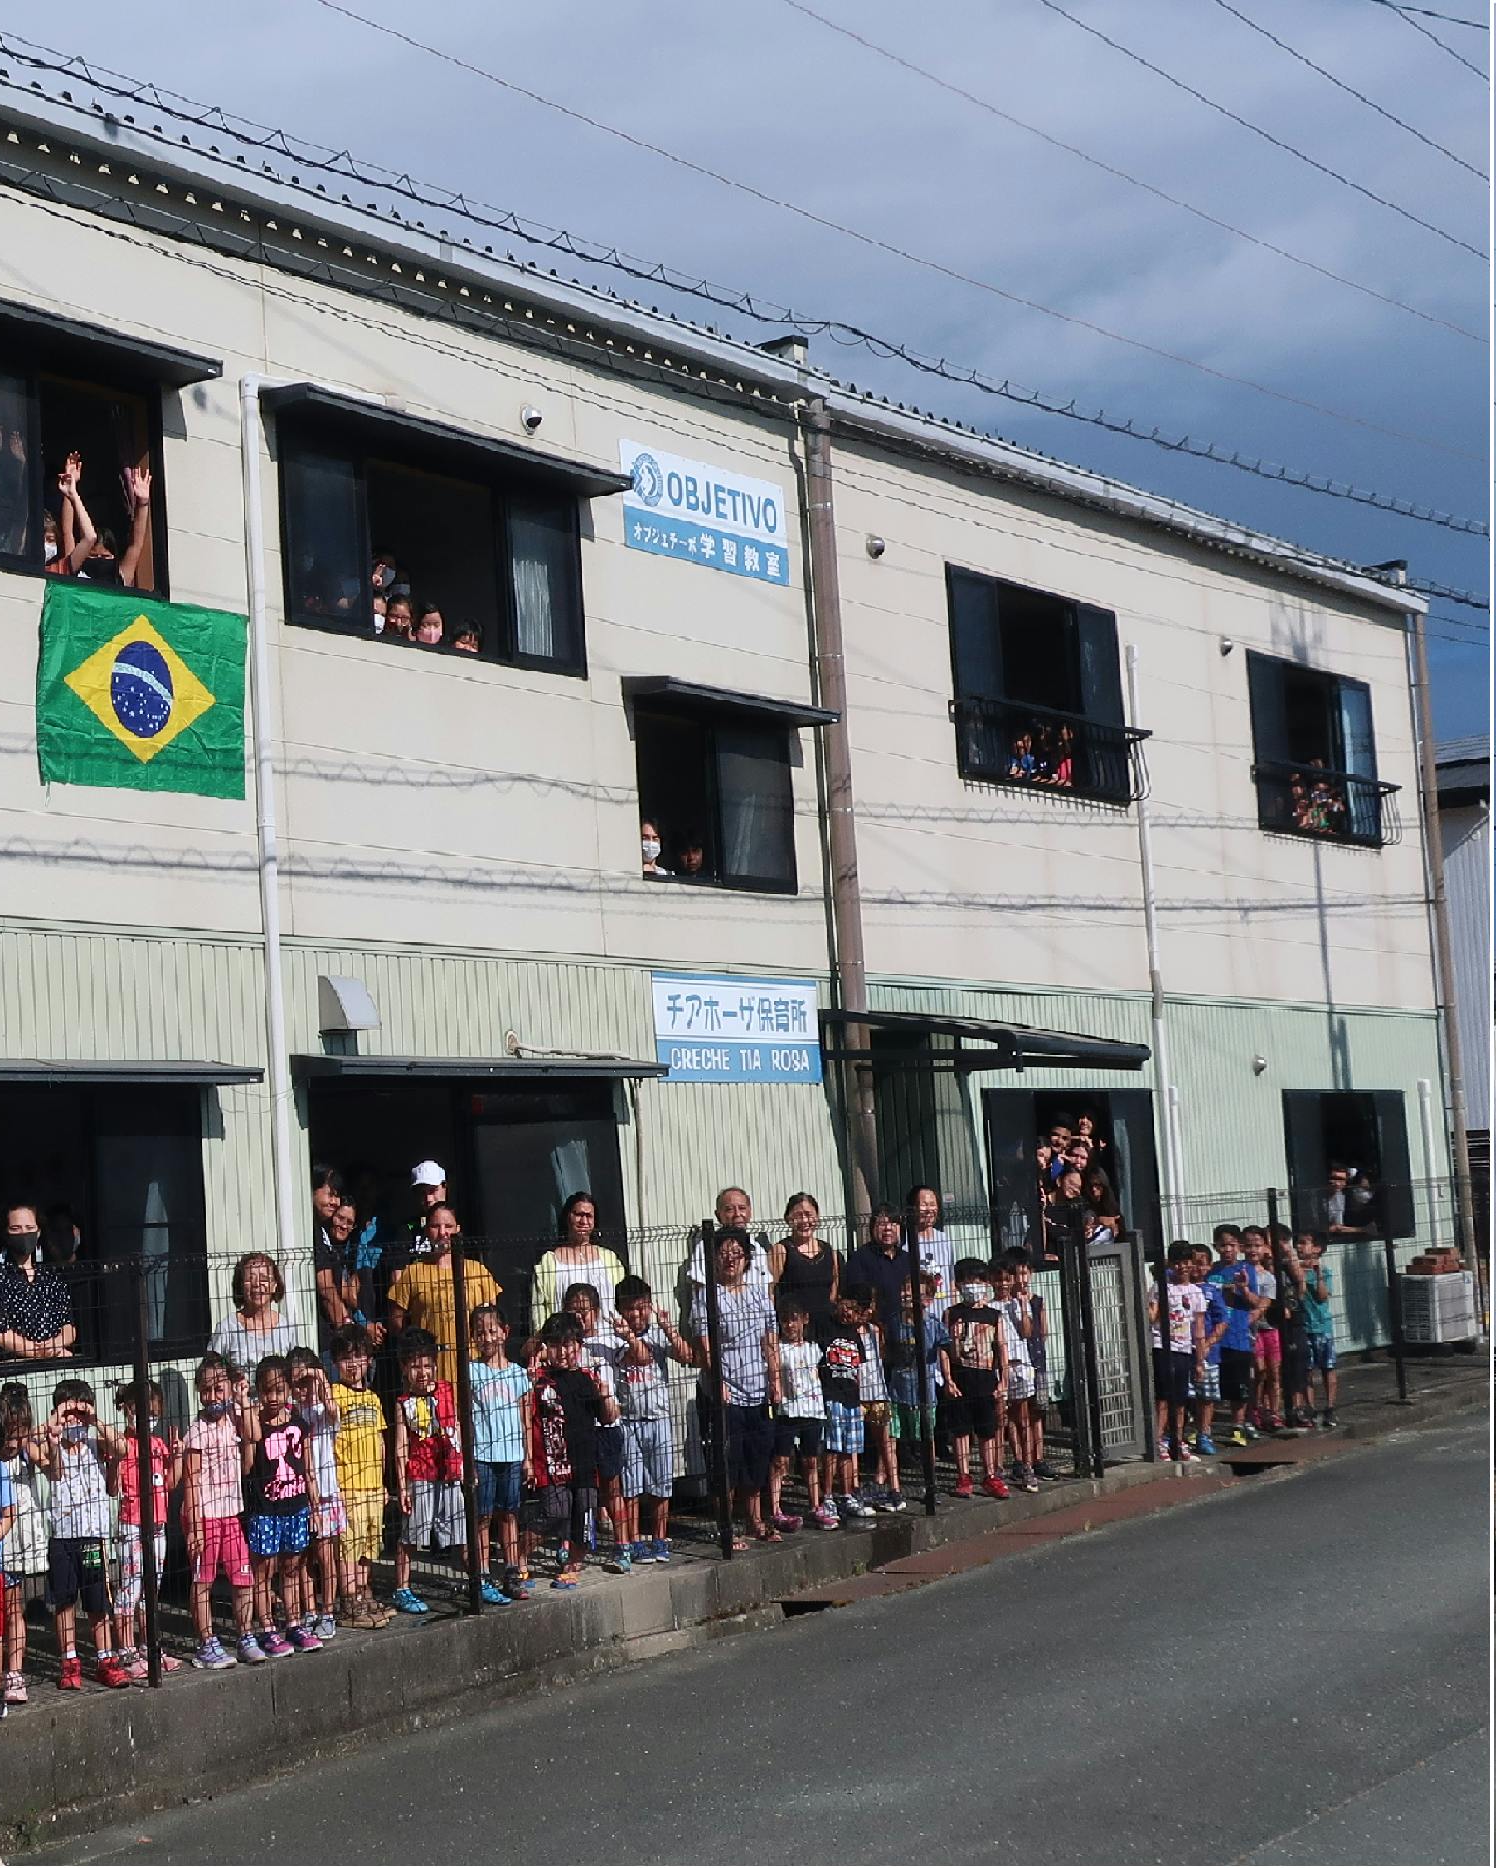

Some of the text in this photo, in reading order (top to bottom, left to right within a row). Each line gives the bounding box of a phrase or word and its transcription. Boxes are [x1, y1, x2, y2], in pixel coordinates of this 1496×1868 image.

[667, 471, 778, 534] OBJETIVO
[666, 993, 808, 1033] チアホーザ保育所
[671, 1047, 810, 1072] CRECHE TIA ROSA
